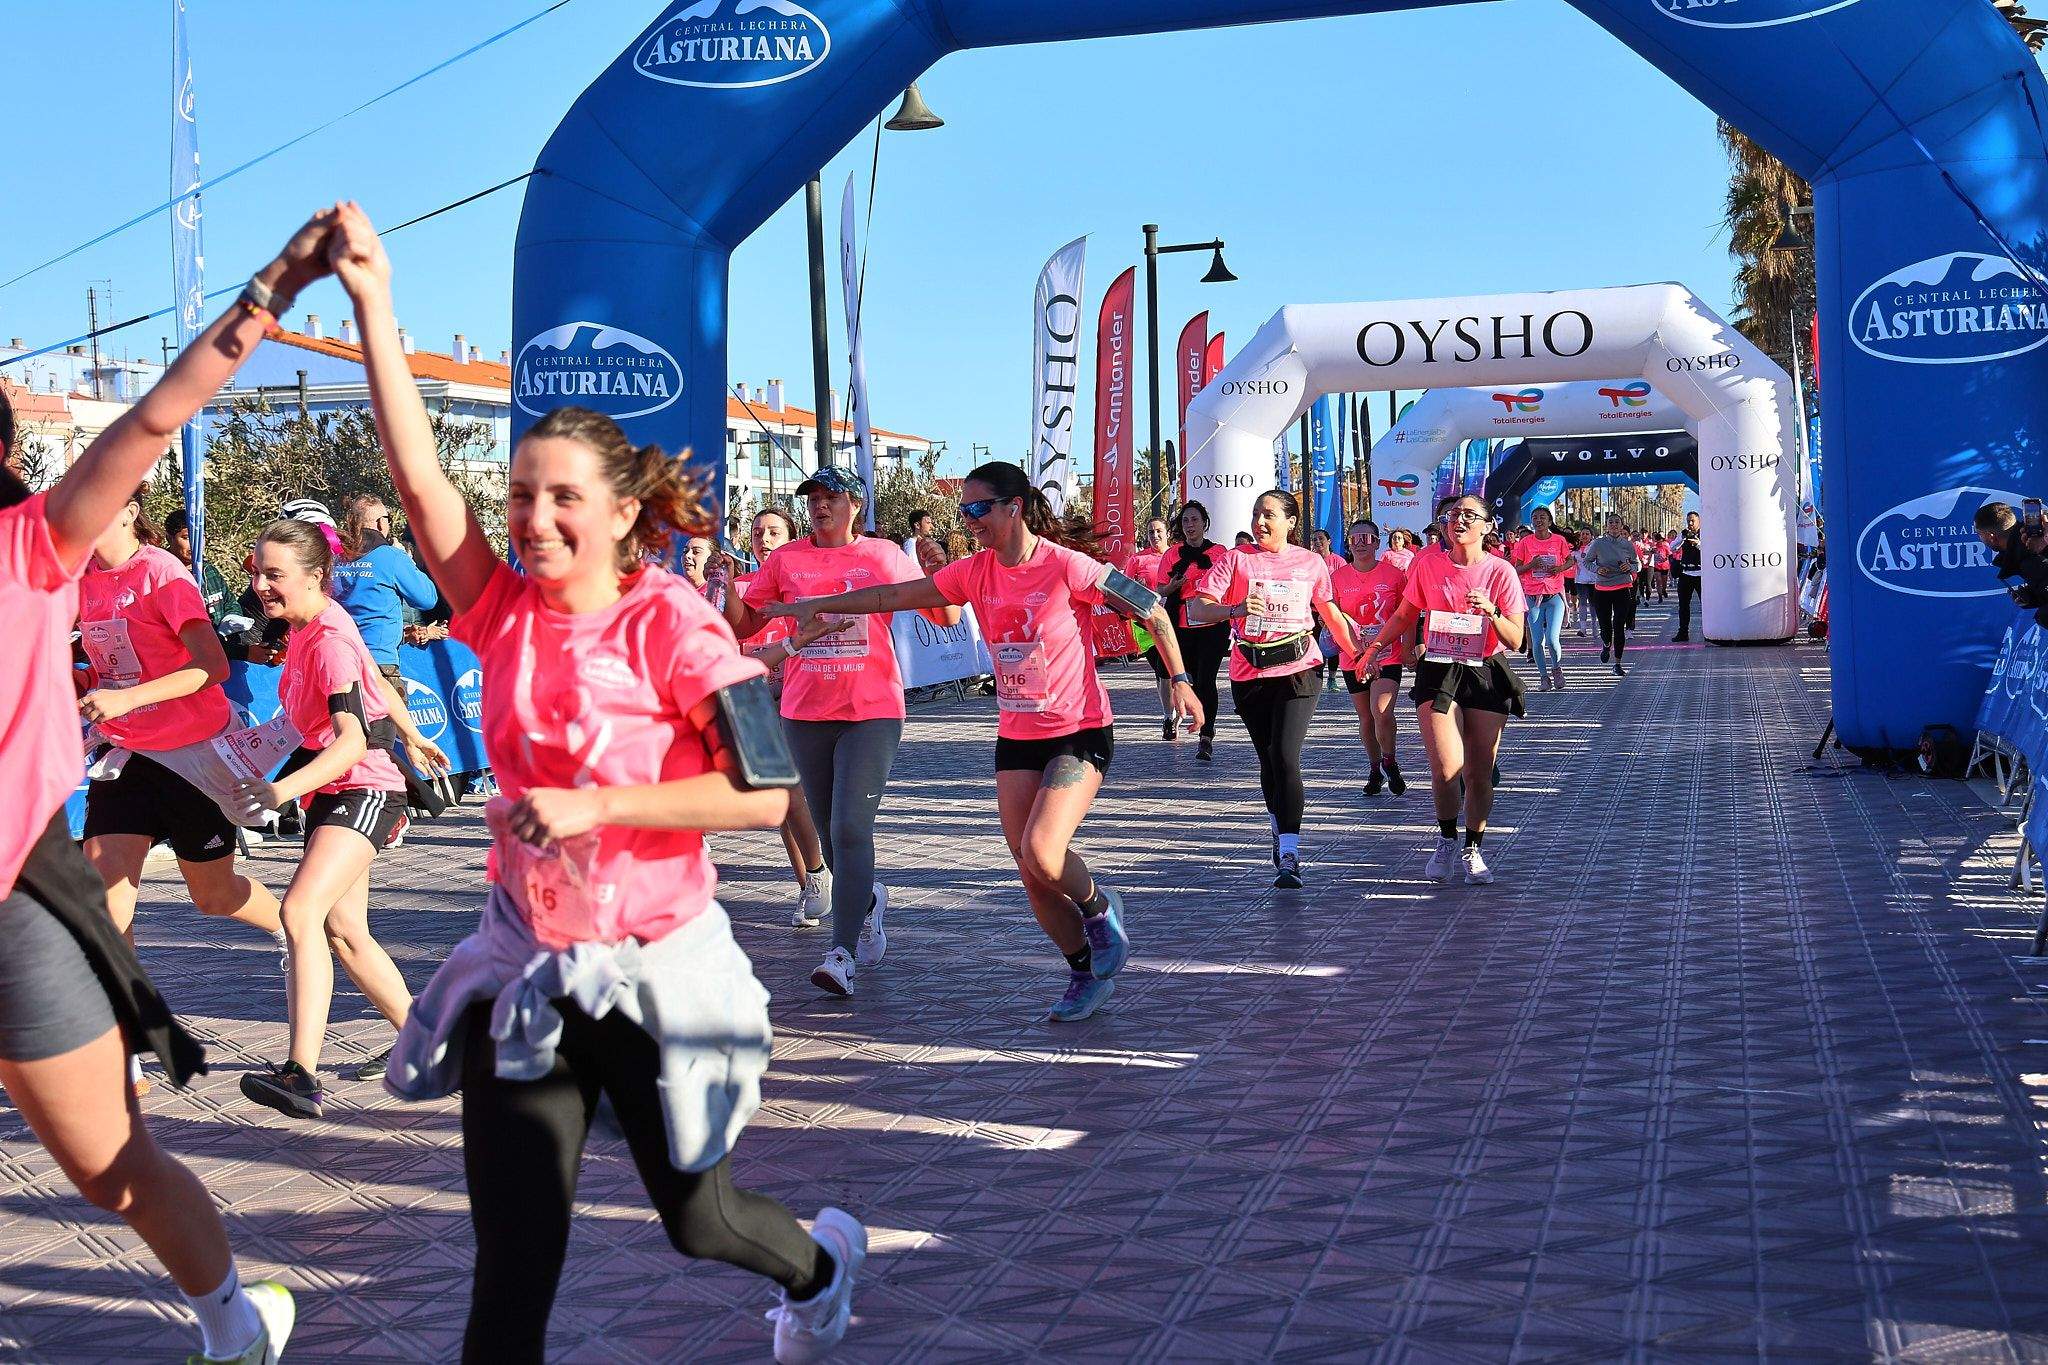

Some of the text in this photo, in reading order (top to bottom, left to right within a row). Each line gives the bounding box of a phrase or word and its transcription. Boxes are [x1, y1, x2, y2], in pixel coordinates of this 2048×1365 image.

[675, 20, 808, 37] CENTRAL LECHERA
[643, 35, 815, 67] ASTURIANA
[1894, 290, 1971, 306] CENTRAL
[1356, 310, 1594, 367] OYSHO
[535, 356, 664, 368] CENTRAL LECHERA
[1666, 353, 1741, 373] OYSHO
[518, 361, 670, 398] ASTURIANA
[1107, 310, 1124, 438] Santander
[1221, 380, 1289, 396] OYSHO
[1492, 416, 1546, 425] TotalEnergies
[1600, 411, 1653, 420] TotalEnergies
[1551, 446, 1670, 462] VOLVO
[1711, 453, 1780, 471] OYSHO
[1192, 474, 1254, 490] OYSHO
[1377, 500, 1420, 508] TotalEnergies
[1104, 477, 1125, 553] Sports
[1713, 552, 1782, 569] OYSHO
[1268, 603, 1289, 613] 016
[1448, 636, 1470, 646] 016
[823, 664, 832, 673] DE
[833, 664, 842, 672] LA
[1001, 674, 1026, 686] 016
